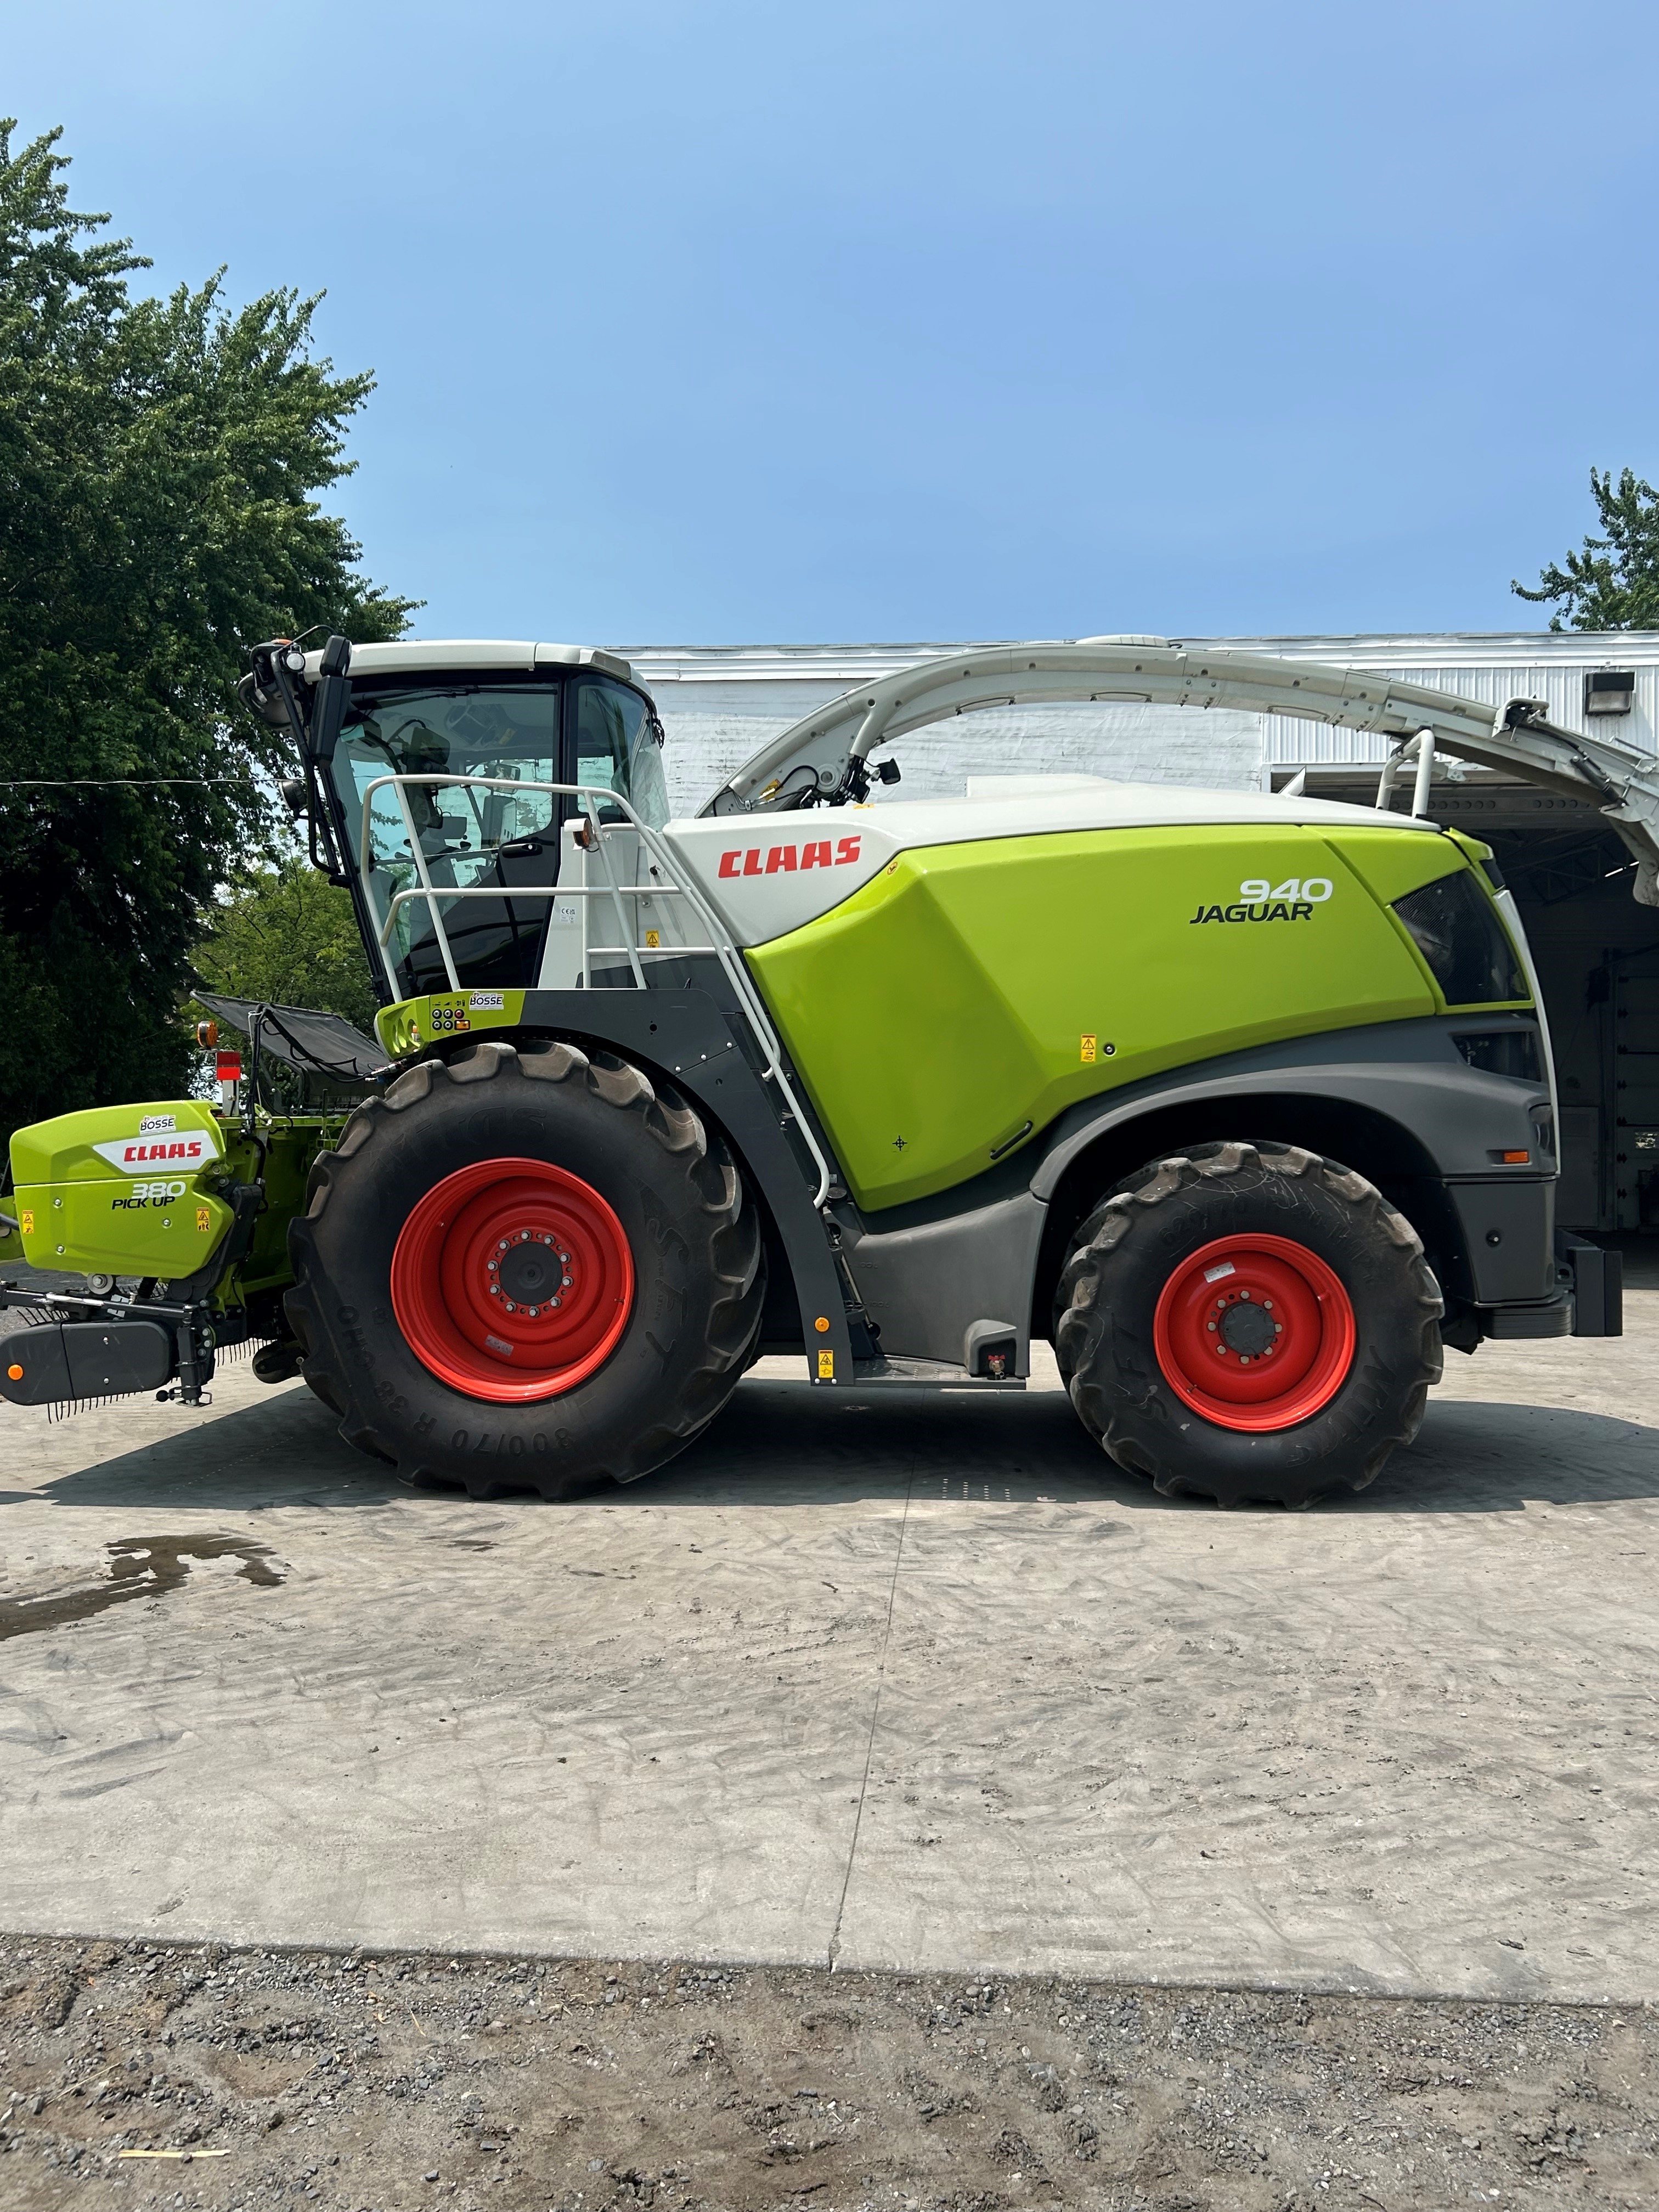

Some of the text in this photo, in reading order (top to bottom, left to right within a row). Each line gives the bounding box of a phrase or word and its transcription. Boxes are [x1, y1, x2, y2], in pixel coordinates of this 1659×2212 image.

[718, 836, 861, 878] CLAAS
[1240, 878, 1333, 904] 940
[1189, 903, 1313, 924] JAGUAR
[470, 997, 503, 1005] BOSSE
[140, 1118, 174, 1131] BOSSE
[124, 1142, 201, 1162] CLAAS
[131, 1181, 186, 1199] 380
[112, 1196, 176, 1210] PICK UP
[373, 1380, 409, 1417] 38
[413, 1411, 438, 1438] R
[451, 1427, 574, 1456] 800/70
